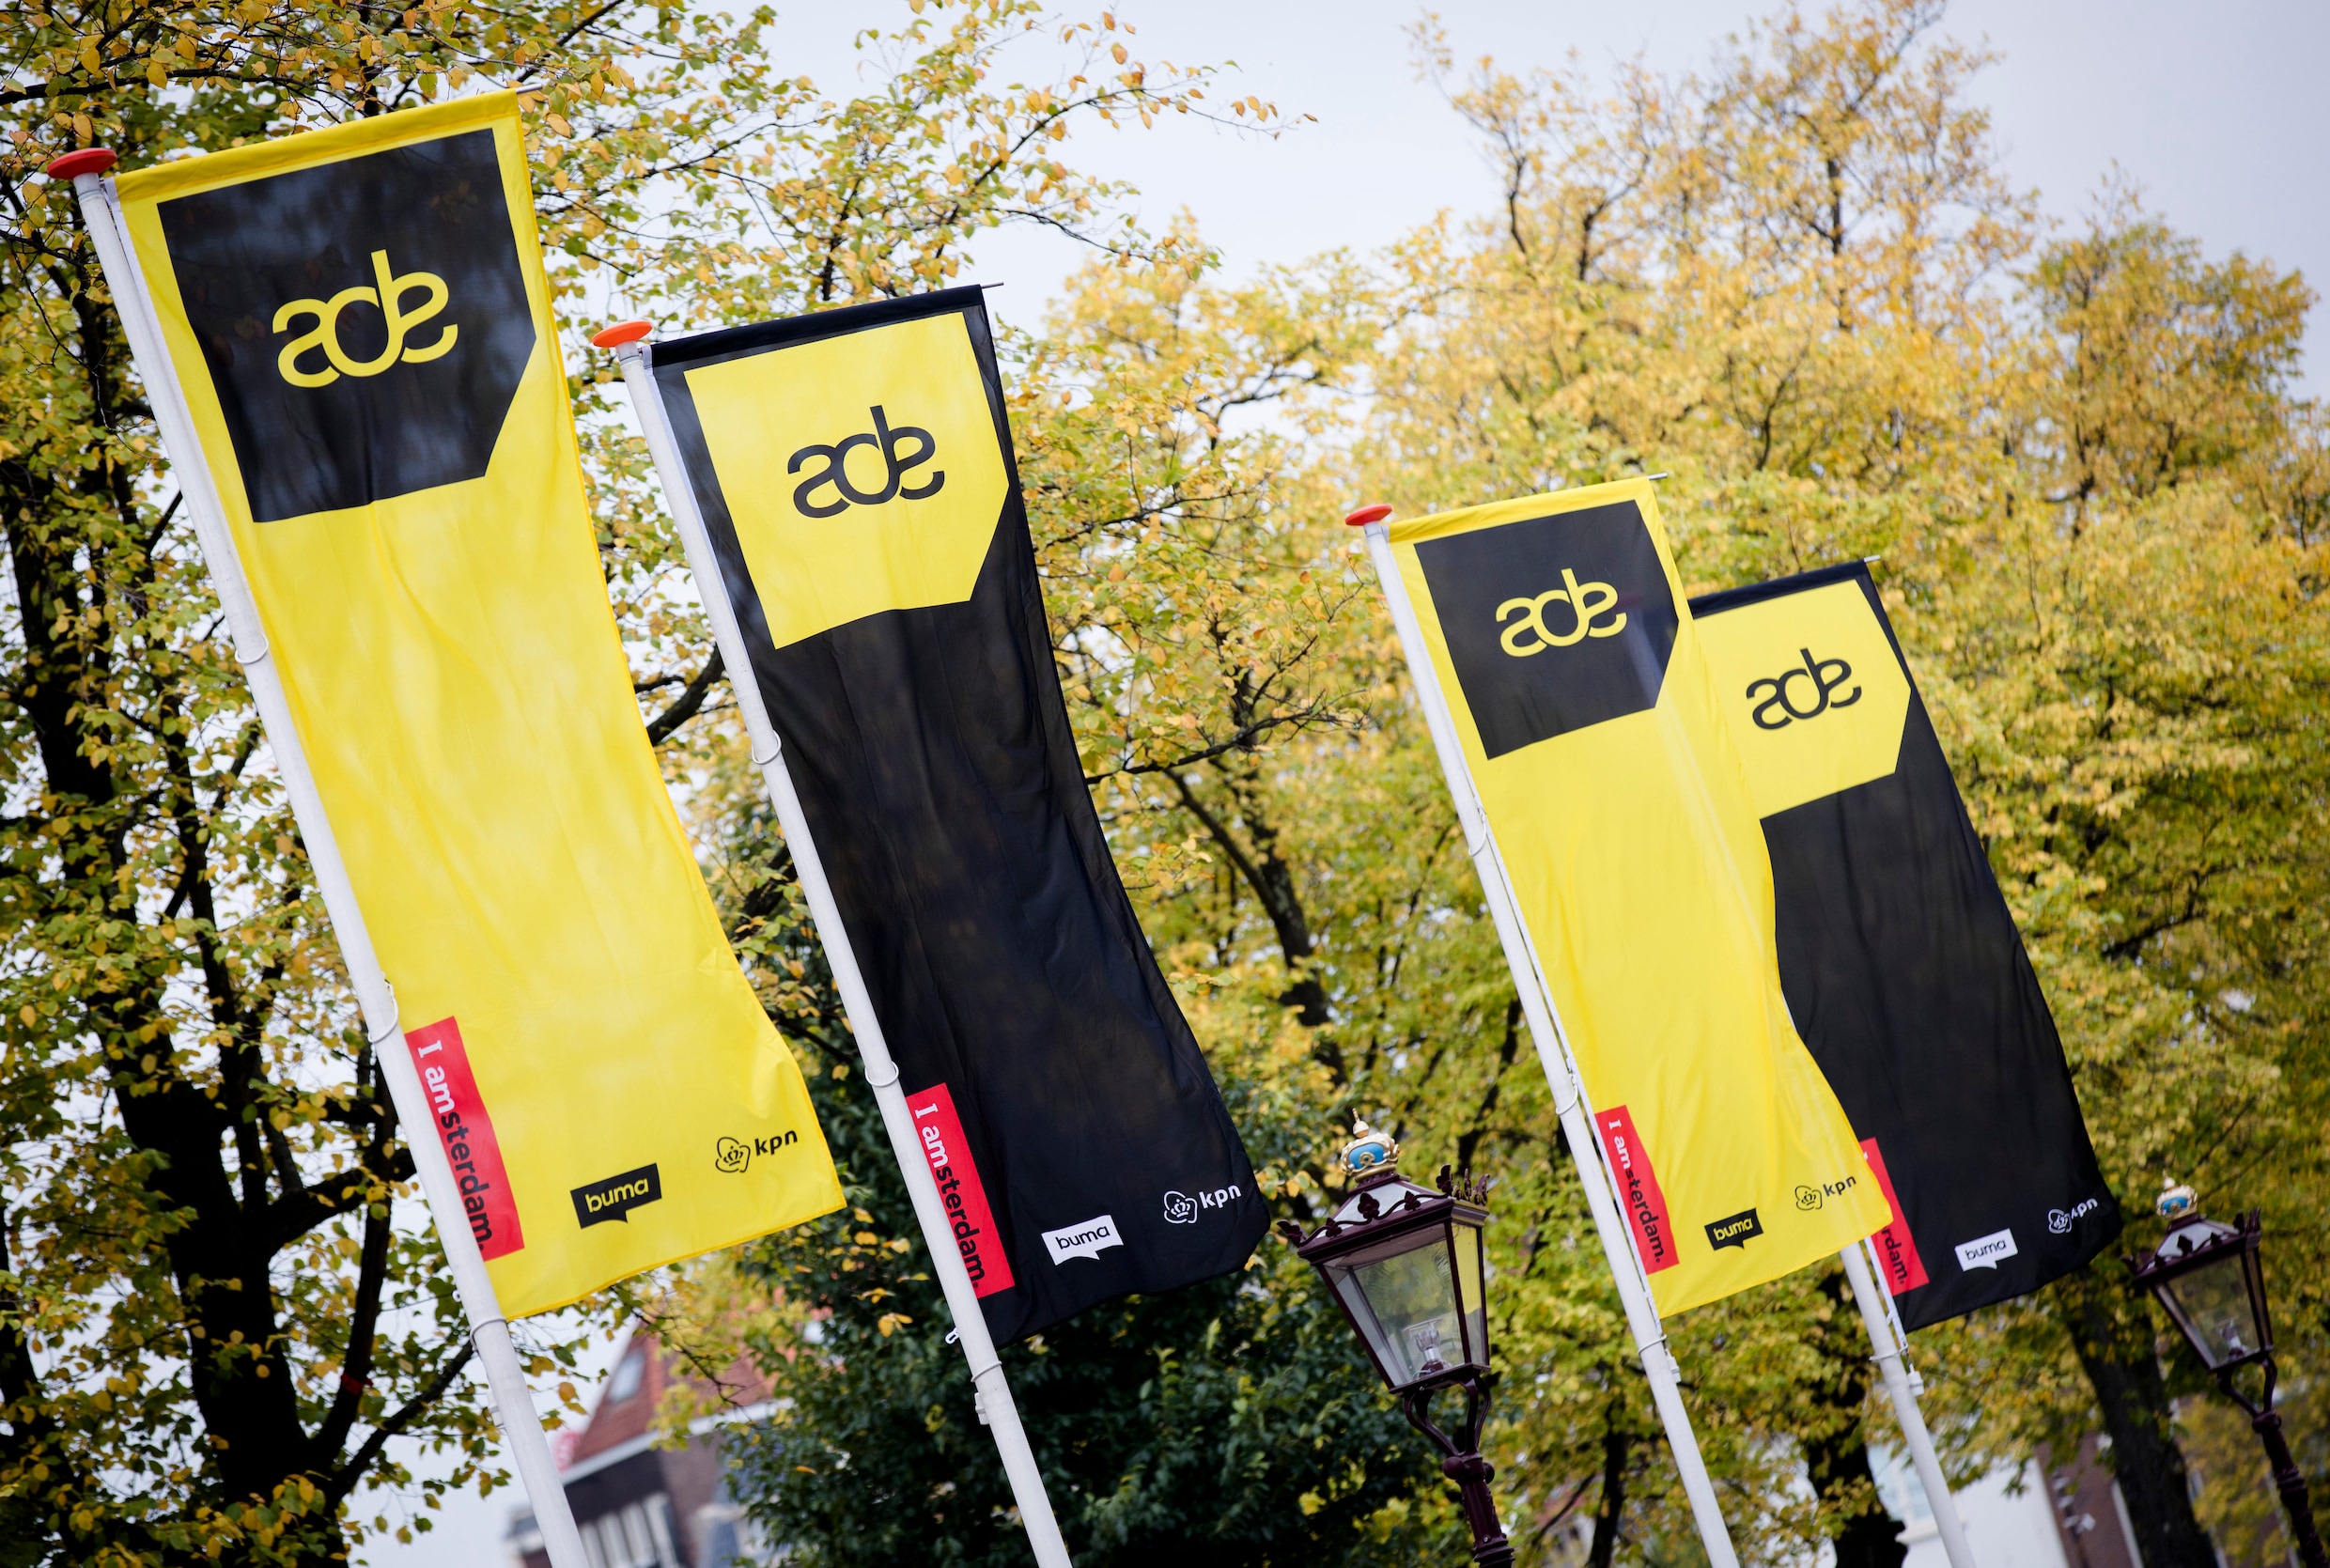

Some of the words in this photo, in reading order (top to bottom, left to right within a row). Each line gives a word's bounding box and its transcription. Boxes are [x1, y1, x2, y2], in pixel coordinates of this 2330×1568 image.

[272, 249, 458, 388] ade
[787, 405, 945, 518] ade
[1496, 567, 1627, 658] ade
[1746, 648, 1862, 730] ade
[418, 1040, 443, 1058] I
[915, 1103, 939, 1119] I
[1608, 1119, 1622, 1129] I
[754, 1130, 798, 1157] kpn
[584, 1178, 649, 1213] buma
[1198, 1185, 1242, 1209] kpn
[1823, 1175, 1856, 1197] kpn
[1054, 1225, 1111, 1250] buma
[1712, 1218, 1753, 1241] buma
[1965, 1239, 2007, 1261] buma
